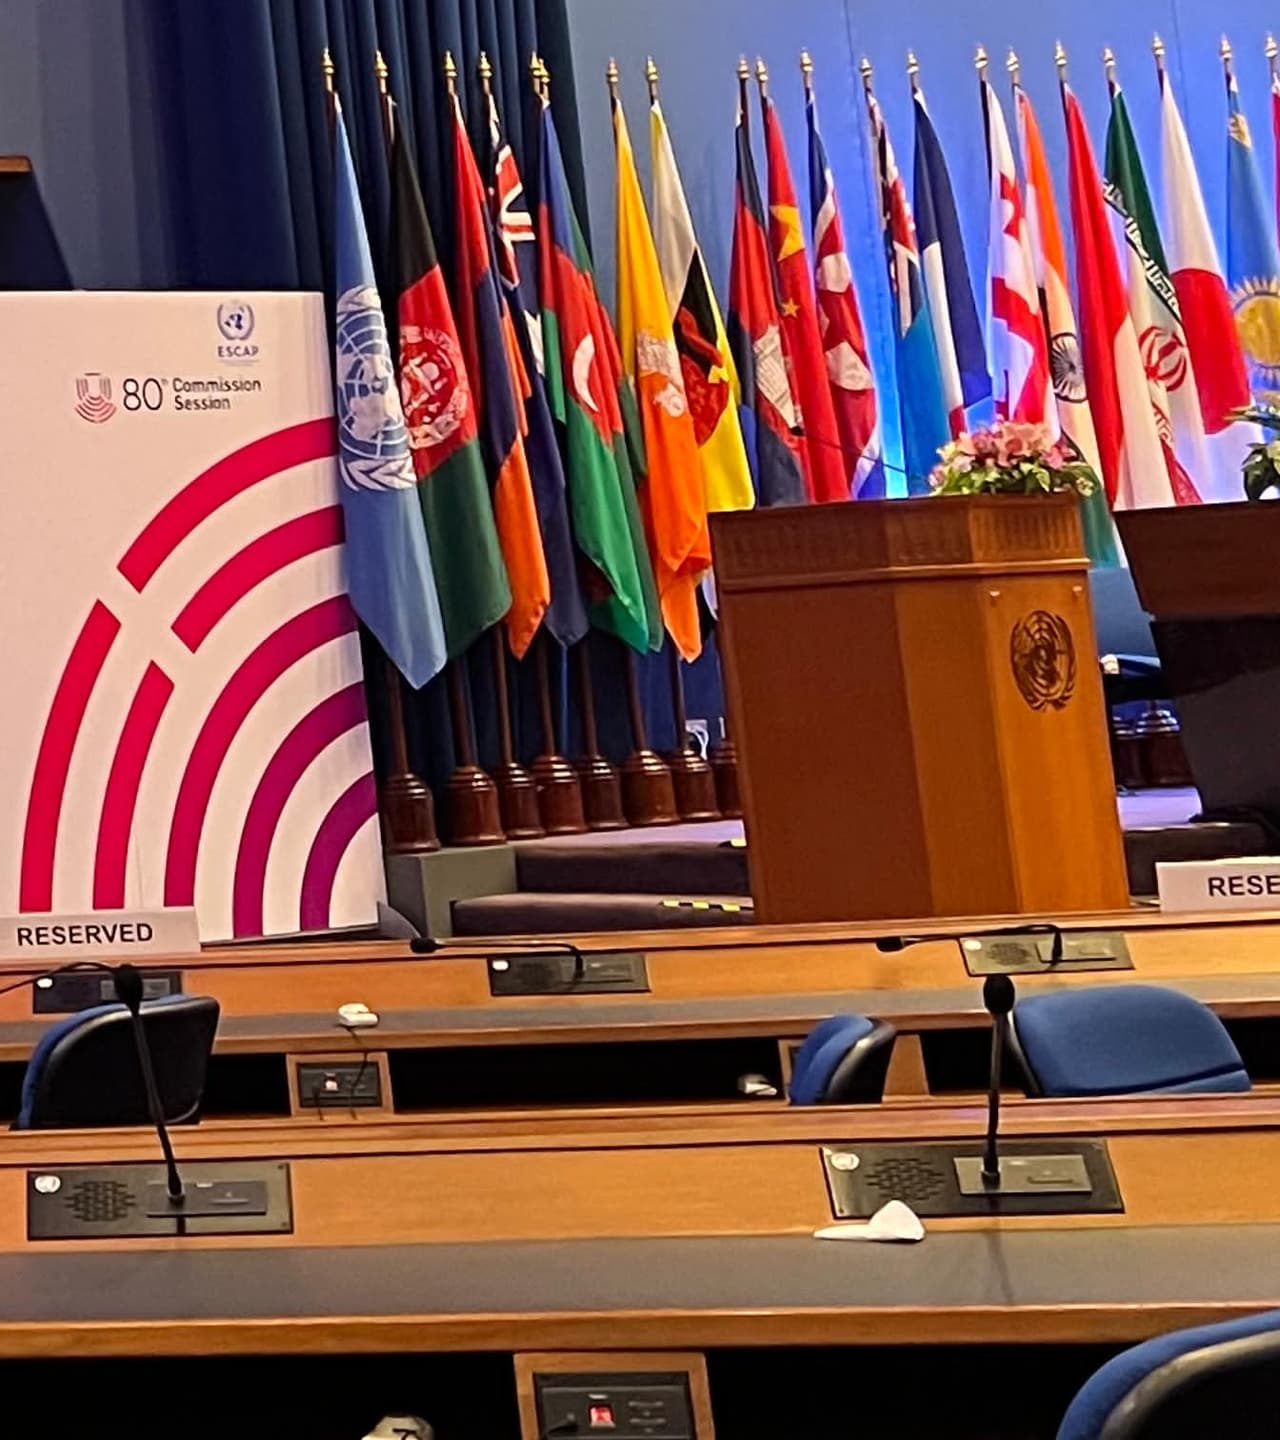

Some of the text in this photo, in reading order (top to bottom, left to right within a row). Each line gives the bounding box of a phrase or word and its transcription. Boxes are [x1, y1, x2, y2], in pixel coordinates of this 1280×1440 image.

[217, 345, 260, 358] ESCAP
[172, 376, 262, 393] Commission
[174, 395, 231, 411] Session
[17, 922, 153, 947] RESERVED
